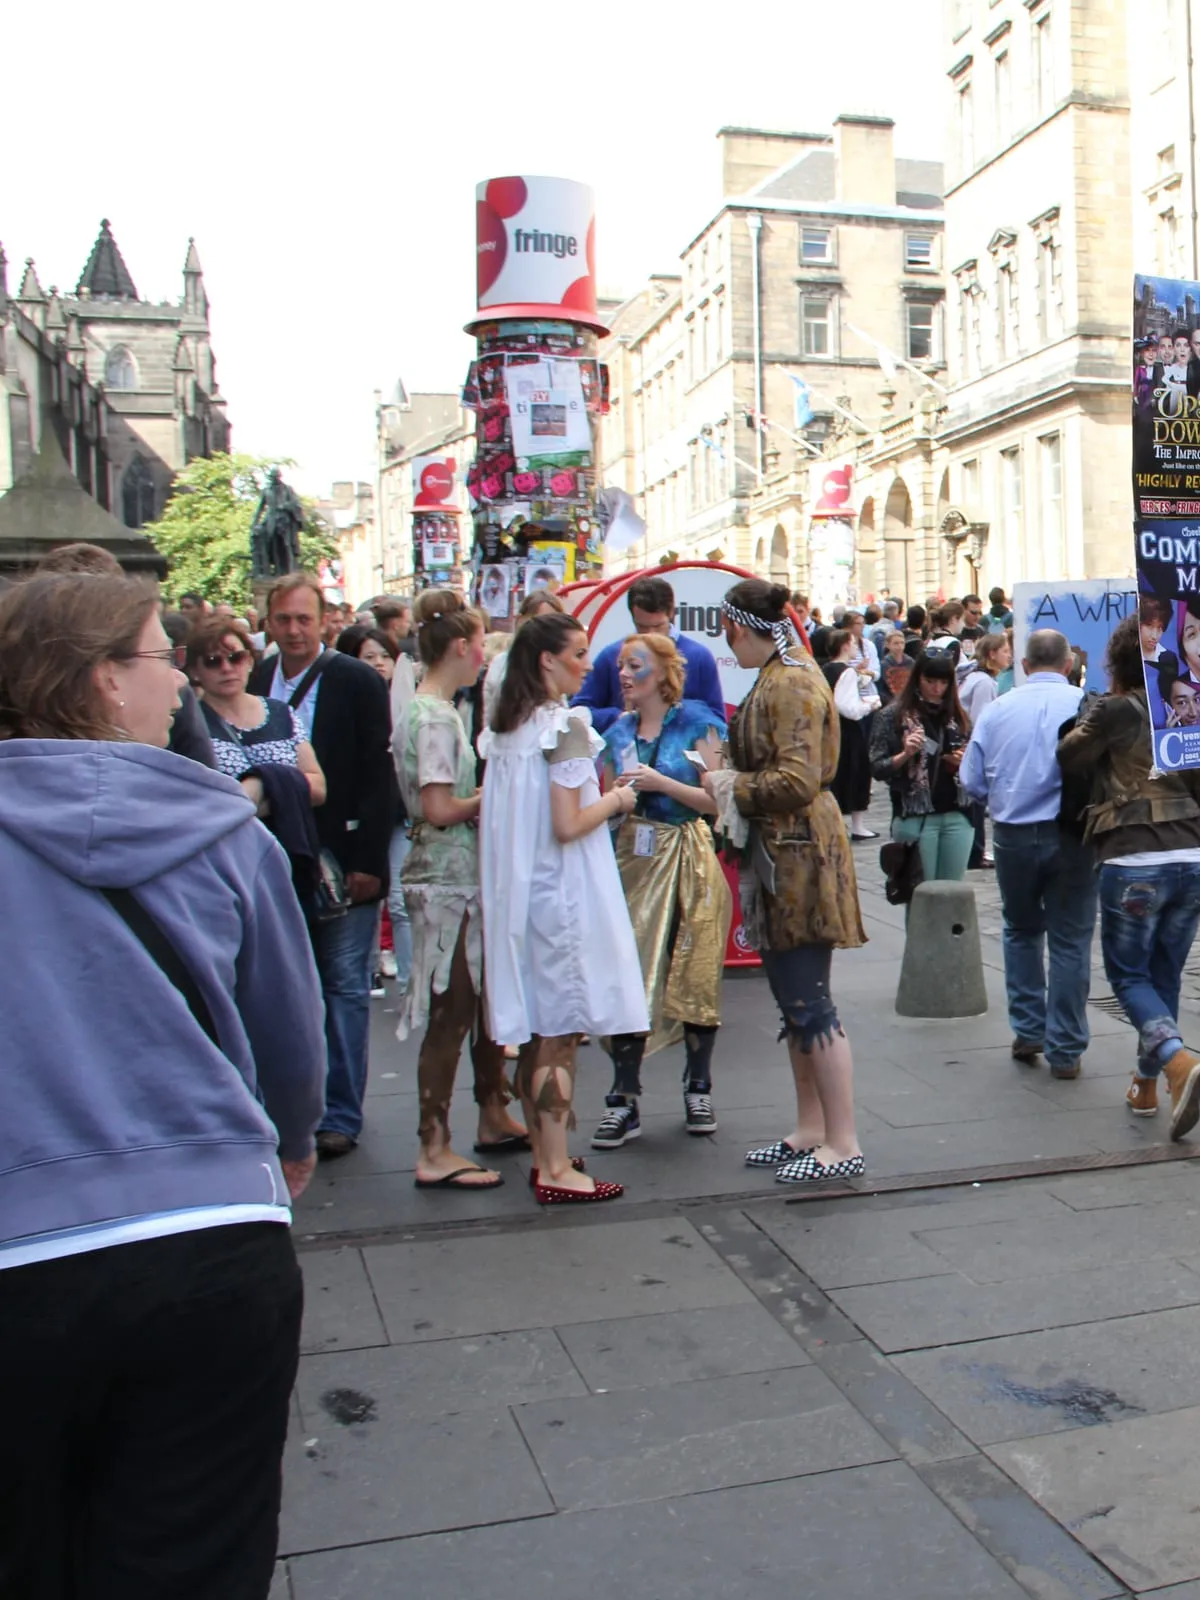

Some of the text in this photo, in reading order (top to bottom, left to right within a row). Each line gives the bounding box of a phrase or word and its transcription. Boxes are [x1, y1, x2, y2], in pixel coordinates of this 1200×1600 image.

[515, 228, 578, 259] fringe
[1153, 445, 1172, 459] THE
[675, 602, 727, 638] ing
[1033, 594, 1059, 623] A
